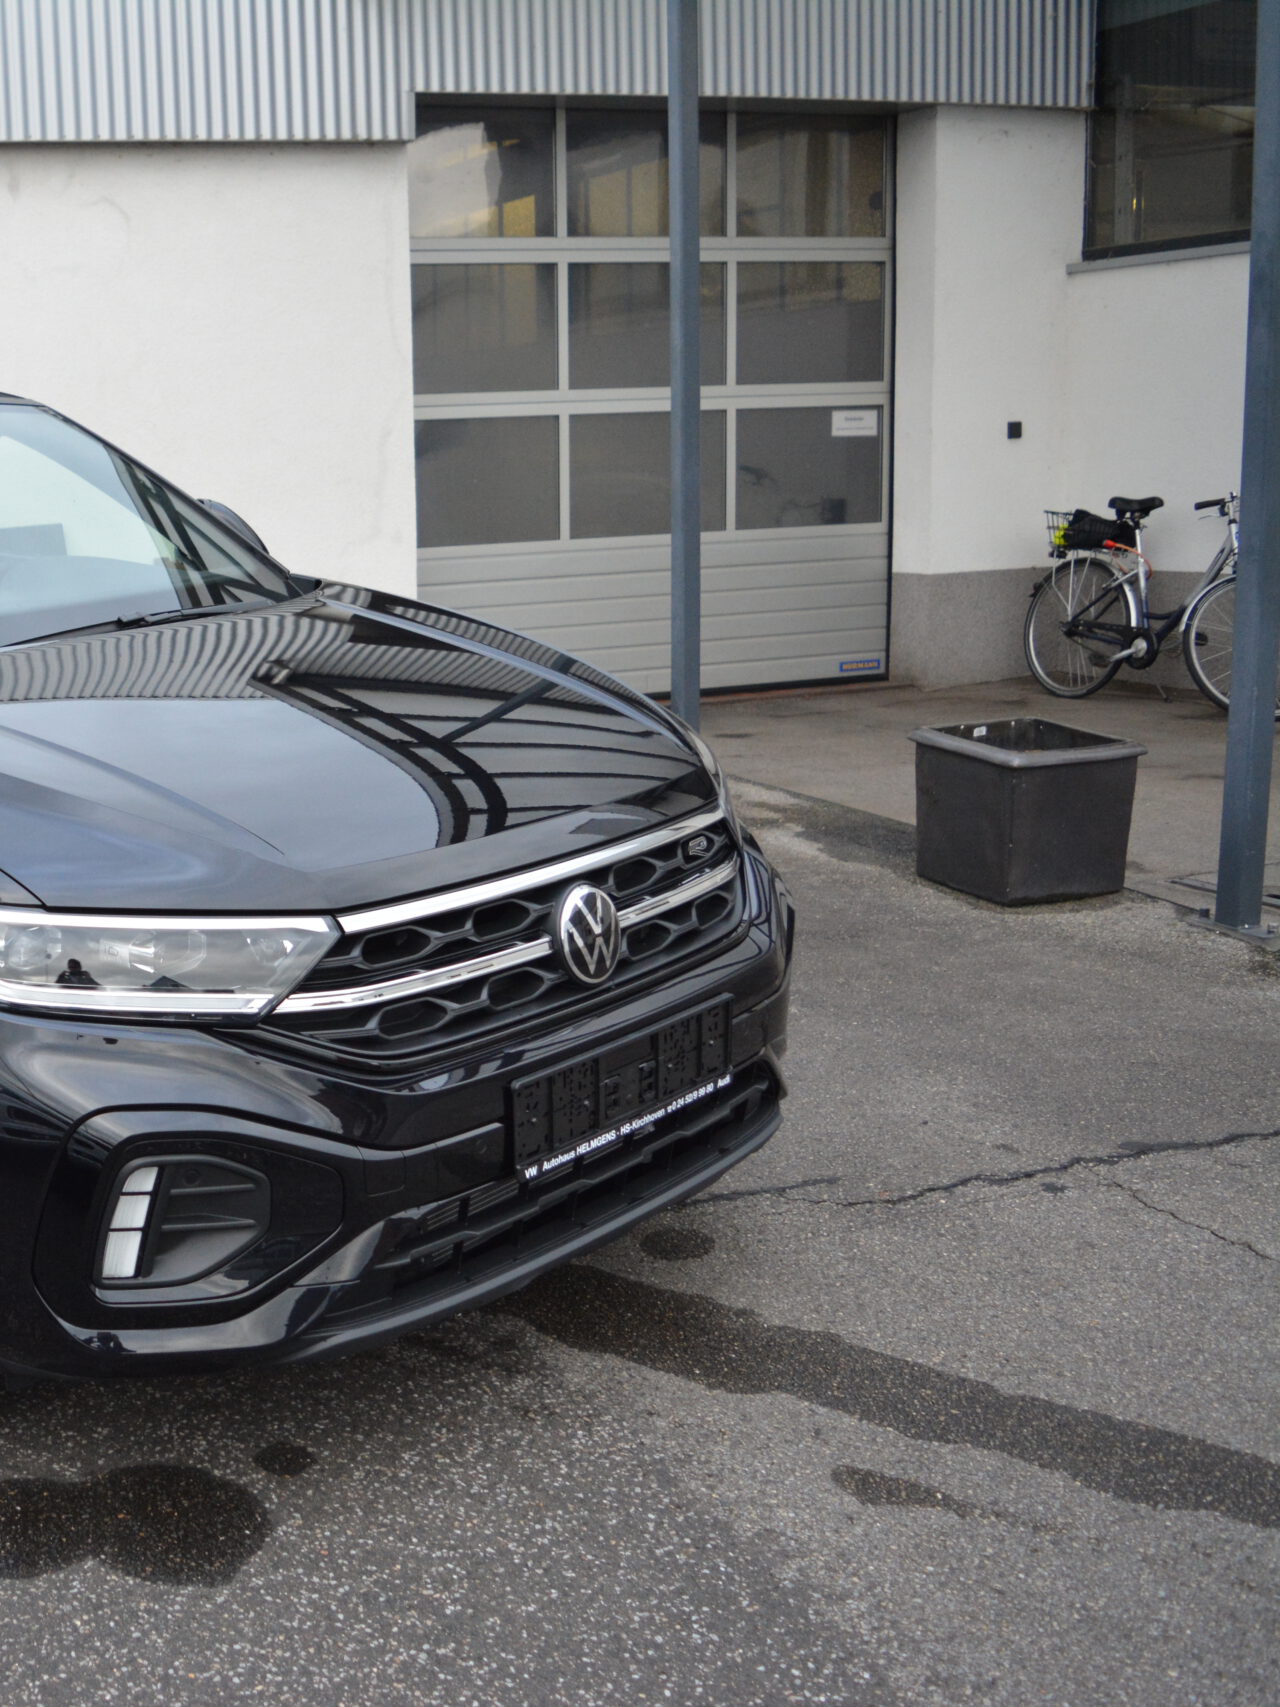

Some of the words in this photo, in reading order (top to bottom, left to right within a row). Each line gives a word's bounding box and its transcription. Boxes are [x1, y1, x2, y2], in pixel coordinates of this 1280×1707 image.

[524, 1165, 538, 1179] VW
[542, 1151, 576, 1171] Autohaus
[576, 1130, 617, 1156] HELMGENS
[620, 1108, 666, 1136] HS-Kirchhoven
[717, 1073, 731, 1089] Audi
